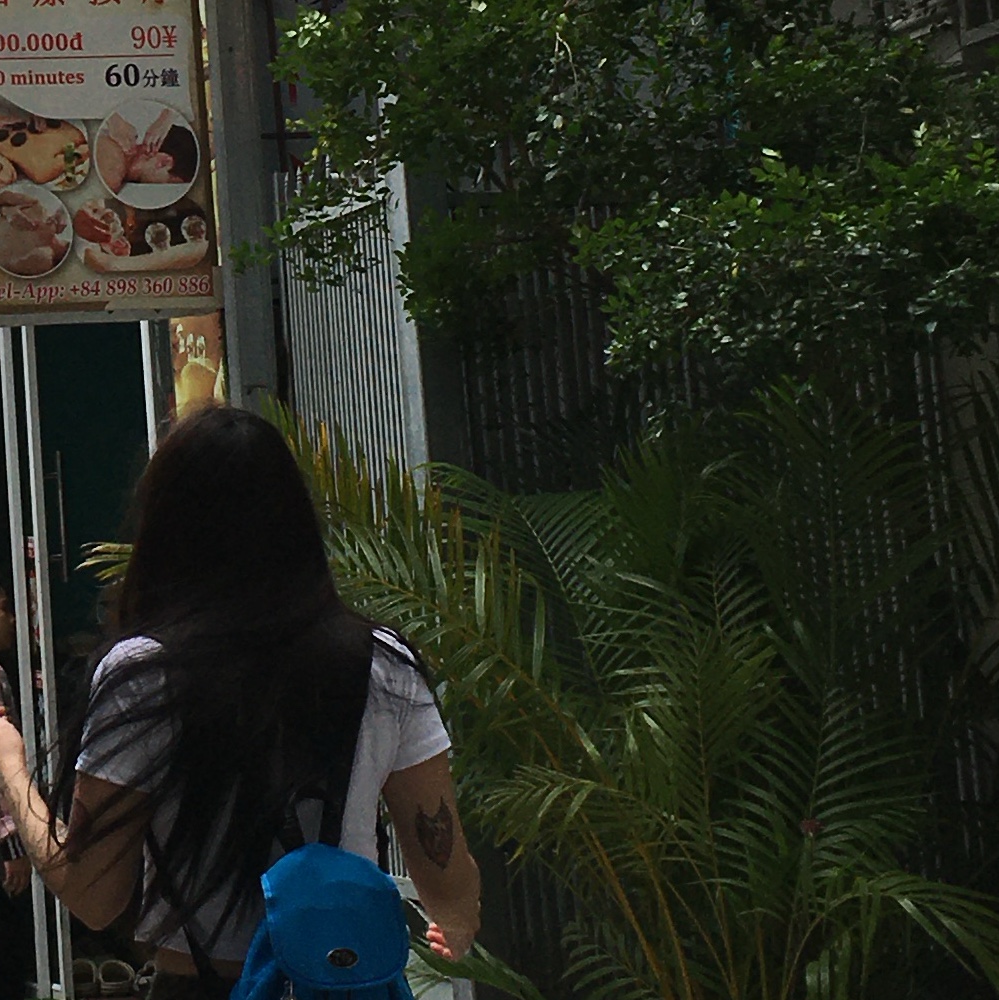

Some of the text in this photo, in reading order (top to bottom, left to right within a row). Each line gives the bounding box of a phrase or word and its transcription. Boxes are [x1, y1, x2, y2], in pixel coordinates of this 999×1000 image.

[131, 25, 178, 49] 90¥
[10, 69, 84, 86] minutes
[69, 281, 101, 296] +84
[105, 279, 137, 295] 898
[142, 277, 172, 295] 360
[177, 276, 210, 294] 886
